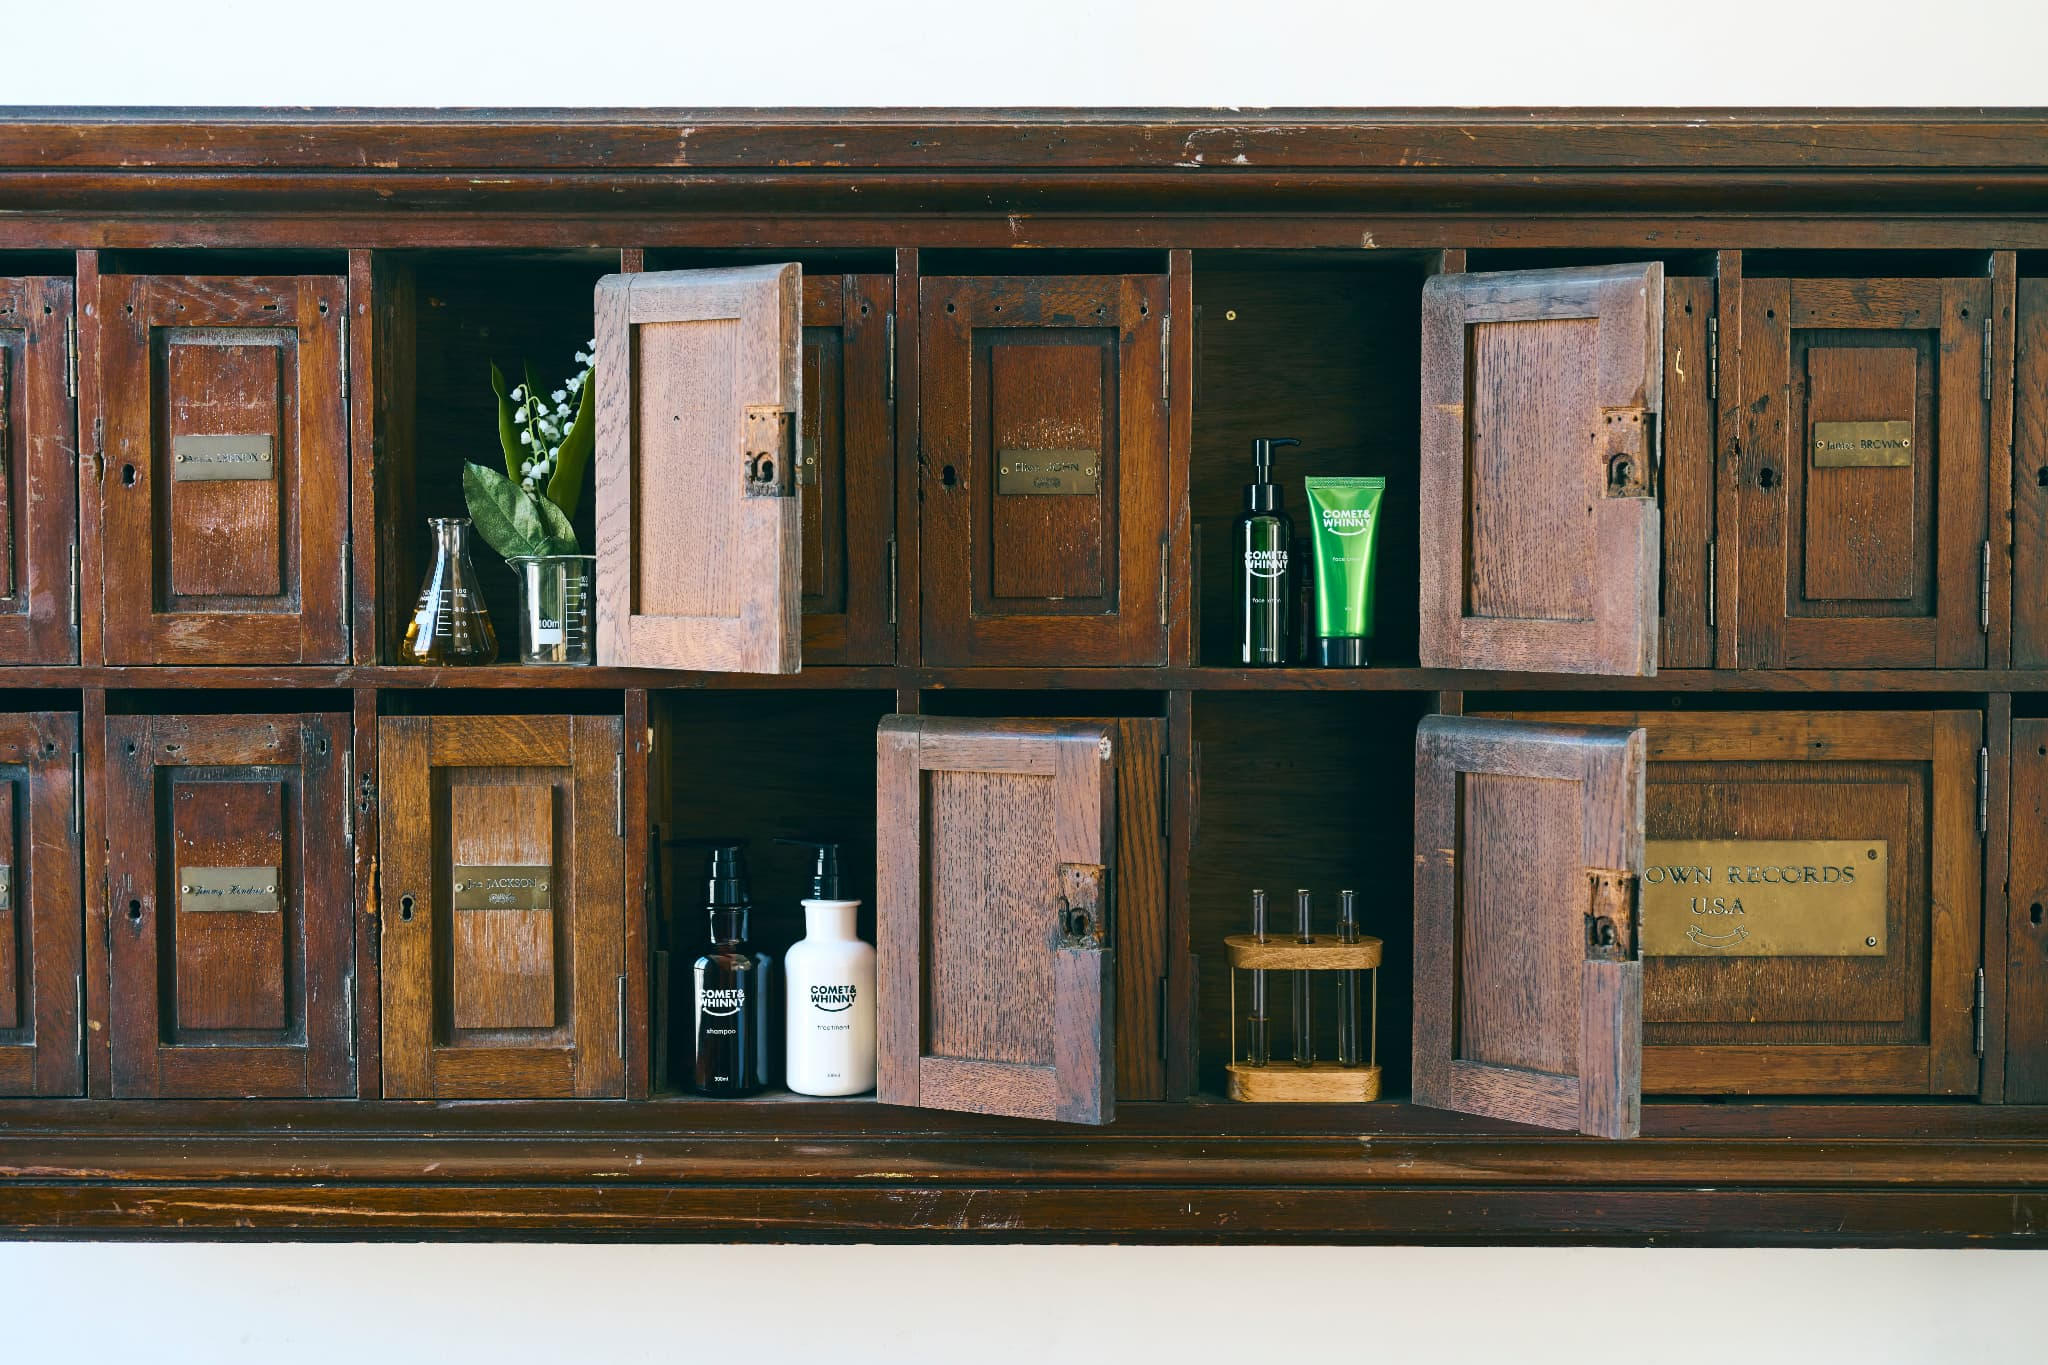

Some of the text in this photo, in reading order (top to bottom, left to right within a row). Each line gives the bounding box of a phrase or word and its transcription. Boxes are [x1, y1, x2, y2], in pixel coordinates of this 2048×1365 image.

[1827, 439, 1902, 451] James BROWN
[1322, 509, 1371, 519] COMET&
[1323, 519, 1371, 528] WHINNY
[1244, 550, 1289, 560] COMET&
[1244, 560, 1289, 569] WHINNY
[539, 619, 561, 628] 100m
[1727, 866, 1856, 885] RECORDS
[486, 878, 538, 890] JACKSON
[1691, 897, 1746, 916] U.S.A
[700, 988, 745, 999] COMET&
[810, 984, 857, 995] COMET&
[700, 998, 745, 1008] WHINNY
[810, 994, 857, 1004] WHINNY
[706, 1027, 737, 1036] shampoo
